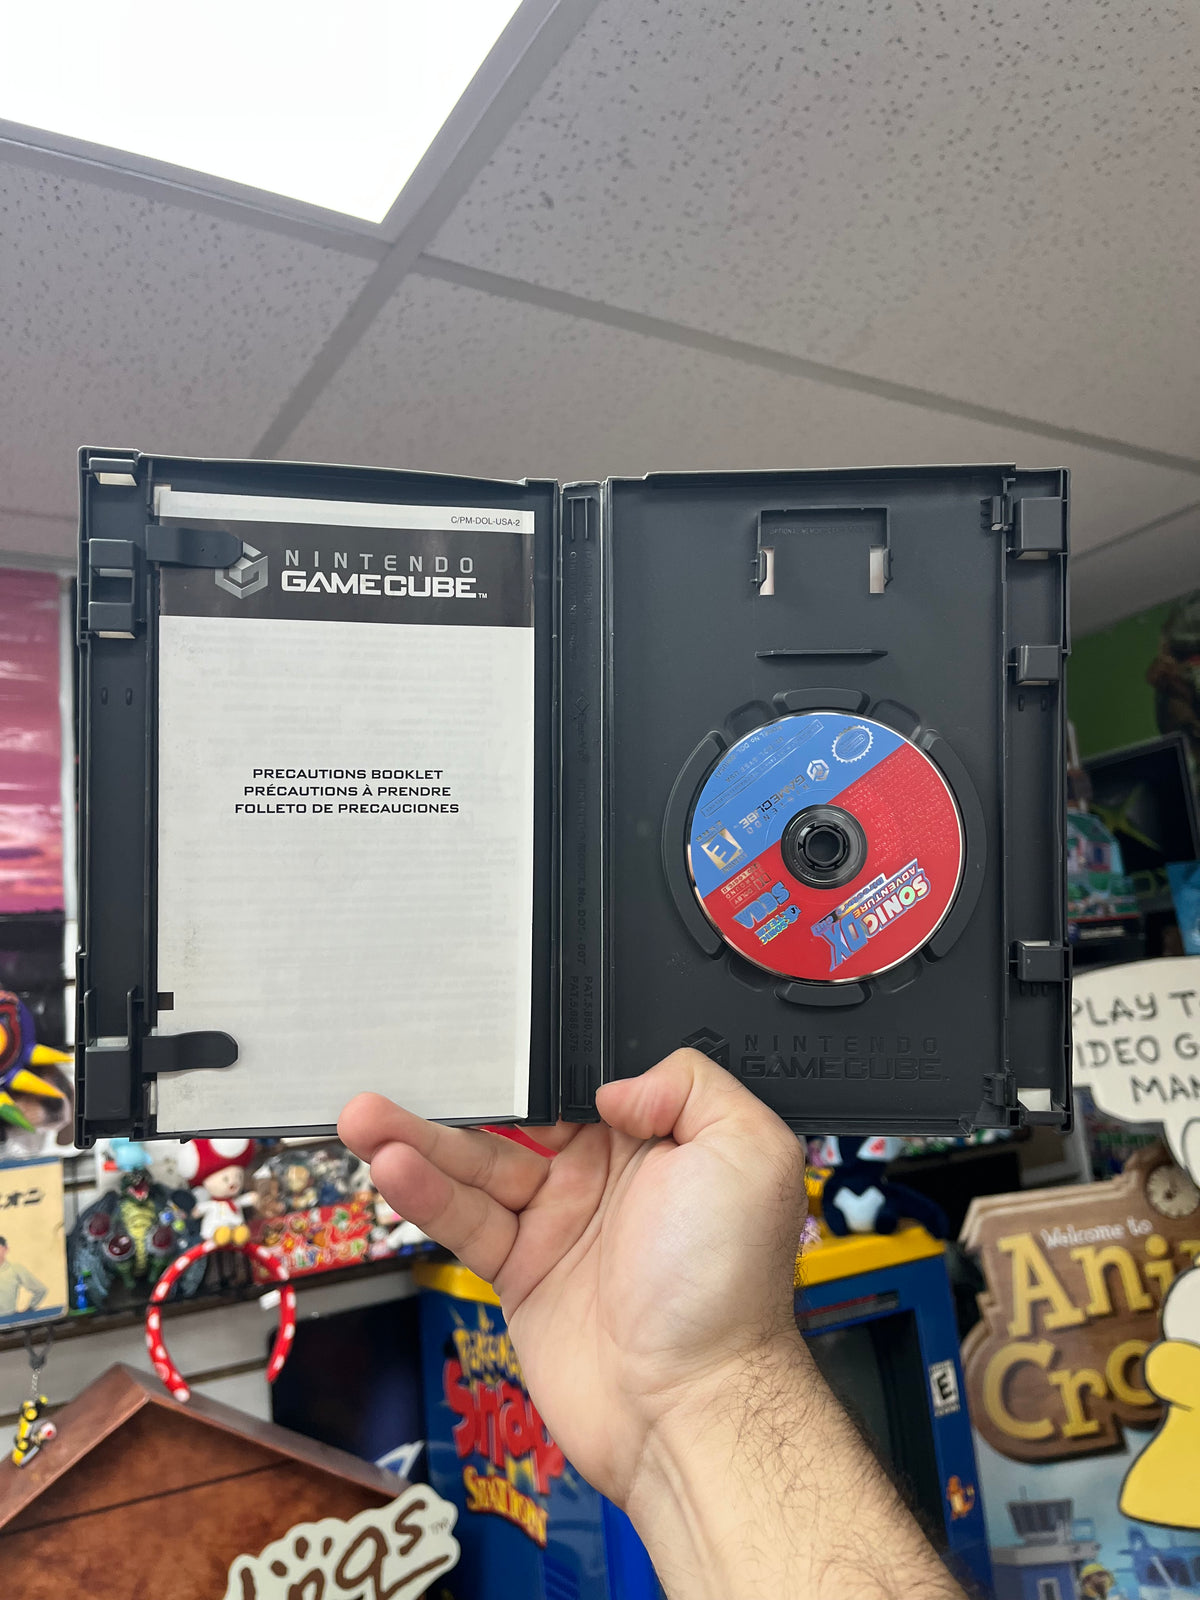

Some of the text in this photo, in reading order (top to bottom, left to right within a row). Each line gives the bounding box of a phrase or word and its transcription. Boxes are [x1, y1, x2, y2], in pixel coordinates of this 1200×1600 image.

[450, 515, 521, 527] C/PM-DOL-USA-2
[285, 549, 474, 574] NINTENDO
[281, 570, 477, 599] GAMECUBE
[252, 768, 444, 780] PRECAUTIONS BOOKLET
[243, 783, 451, 797] PRÉCAUTIONS À PRENDRE
[235, 803, 459, 814] FOLLETO DE PRECAUCIONES
[705, 833, 737, 864] E
[731, 879, 792, 930] SEGA
[851, 865, 917, 919] ADVENTURE
[758, 919, 790, 945] SONIC
[819, 873, 930, 972] SONIC DX
[1168, 989, 1200, 1019] T
[744, 1033, 939, 1055] NINTENDO
[1075, 1035, 1161, 1069] IDEO
[740, 1054, 943, 1081] GAMECUBE
[1041, 1215, 1153, 1248] Welcome to
[997, 1231, 1200, 1338] Ani
[936, 1372, 954, 1400] E
[983, 1338, 1155, 1441] Cro
